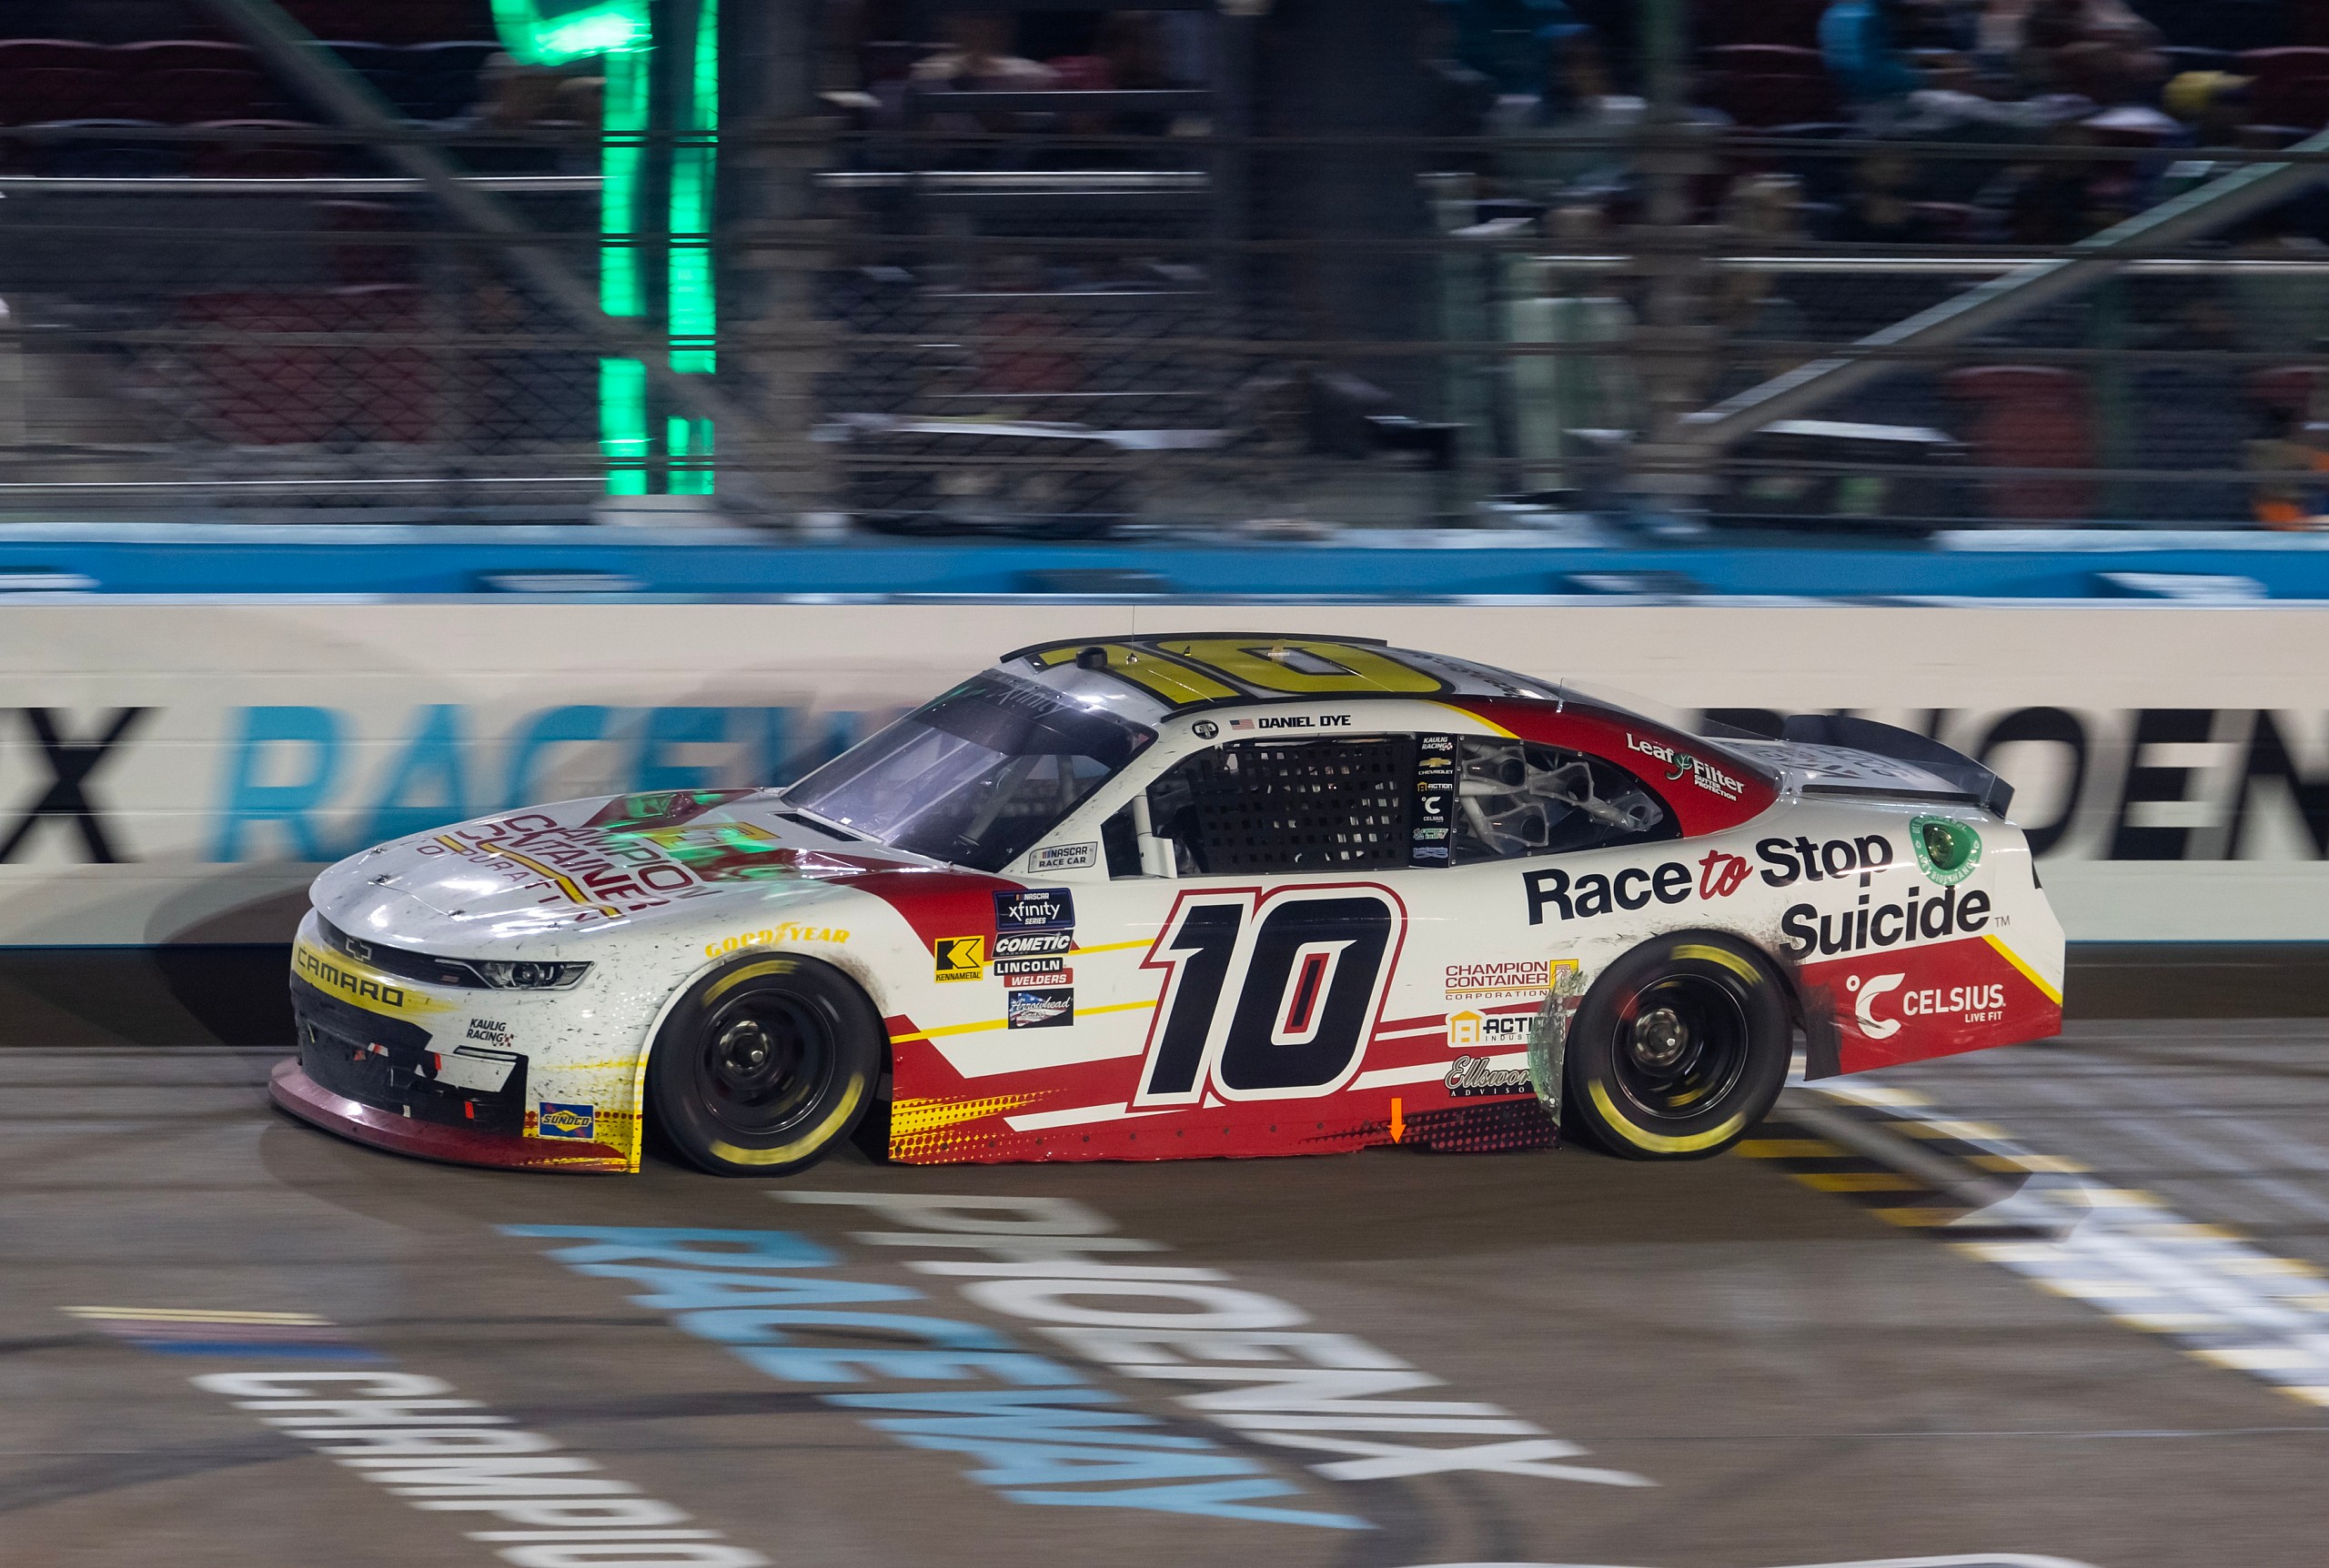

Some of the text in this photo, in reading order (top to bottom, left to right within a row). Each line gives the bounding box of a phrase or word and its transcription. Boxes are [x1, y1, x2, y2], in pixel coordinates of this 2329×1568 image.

[1258, 715, 1352, 729] DANIEL DYE
[1421, 742, 1447, 750] RACING
[1423, 736, 1448, 744] KAULIG
[1626, 732, 1675, 764] Leaf
[1692, 759, 1745, 794] Filter
[1694, 774, 1721, 789] GUTTER
[1694, 779, 1737, 801] PROTECTION
[1051, 846, 1088, 858] NASCAR
[1039, 856, 1086, 868] RACE CAR
[1522, 834, 1894, 926] Race to Stop
[1023, 892, 1050, 900] NASCAR
[1008, 901, 1061, 921] xfinity
[1024, 917, 1046, 925] SERIES
[1779, 885, 1991, 960] Suicide
[705, 922, 851, 959] GOODYEAR
[995, 935, 1071, 953] COMETIC
[996, 960, 1060, 974] LINCOLN
[1446, 960, 1548, 977] CHAMPION
[297, 946, 405, 1008] CAMARO
[935, 971, 981, 981] KENNAMETAL
[1012, 974, 1067, 986] WELDERS
[1446, 973, 1548, 989] CONTAINER
[1132, 886, 1402, 1107] 10
[1445, 990, 1548, 1000] CORPORATION
[1903, 984, 2004, 1016] CELSIUS
[1010, 997, 1071, 1012] Arrowhead
[1965, 1010, 2003, 1023] LIVE FIT
[469, 1018, 507, 1032] KAULIG
[466, 1029, 505, 1043] RACING
[542, 1114, 590, 1126] SUNOCO
[765, 1190, 1661, 1488] PHOENIX
[490, 1223, 1383, 1531] RACEWAY
